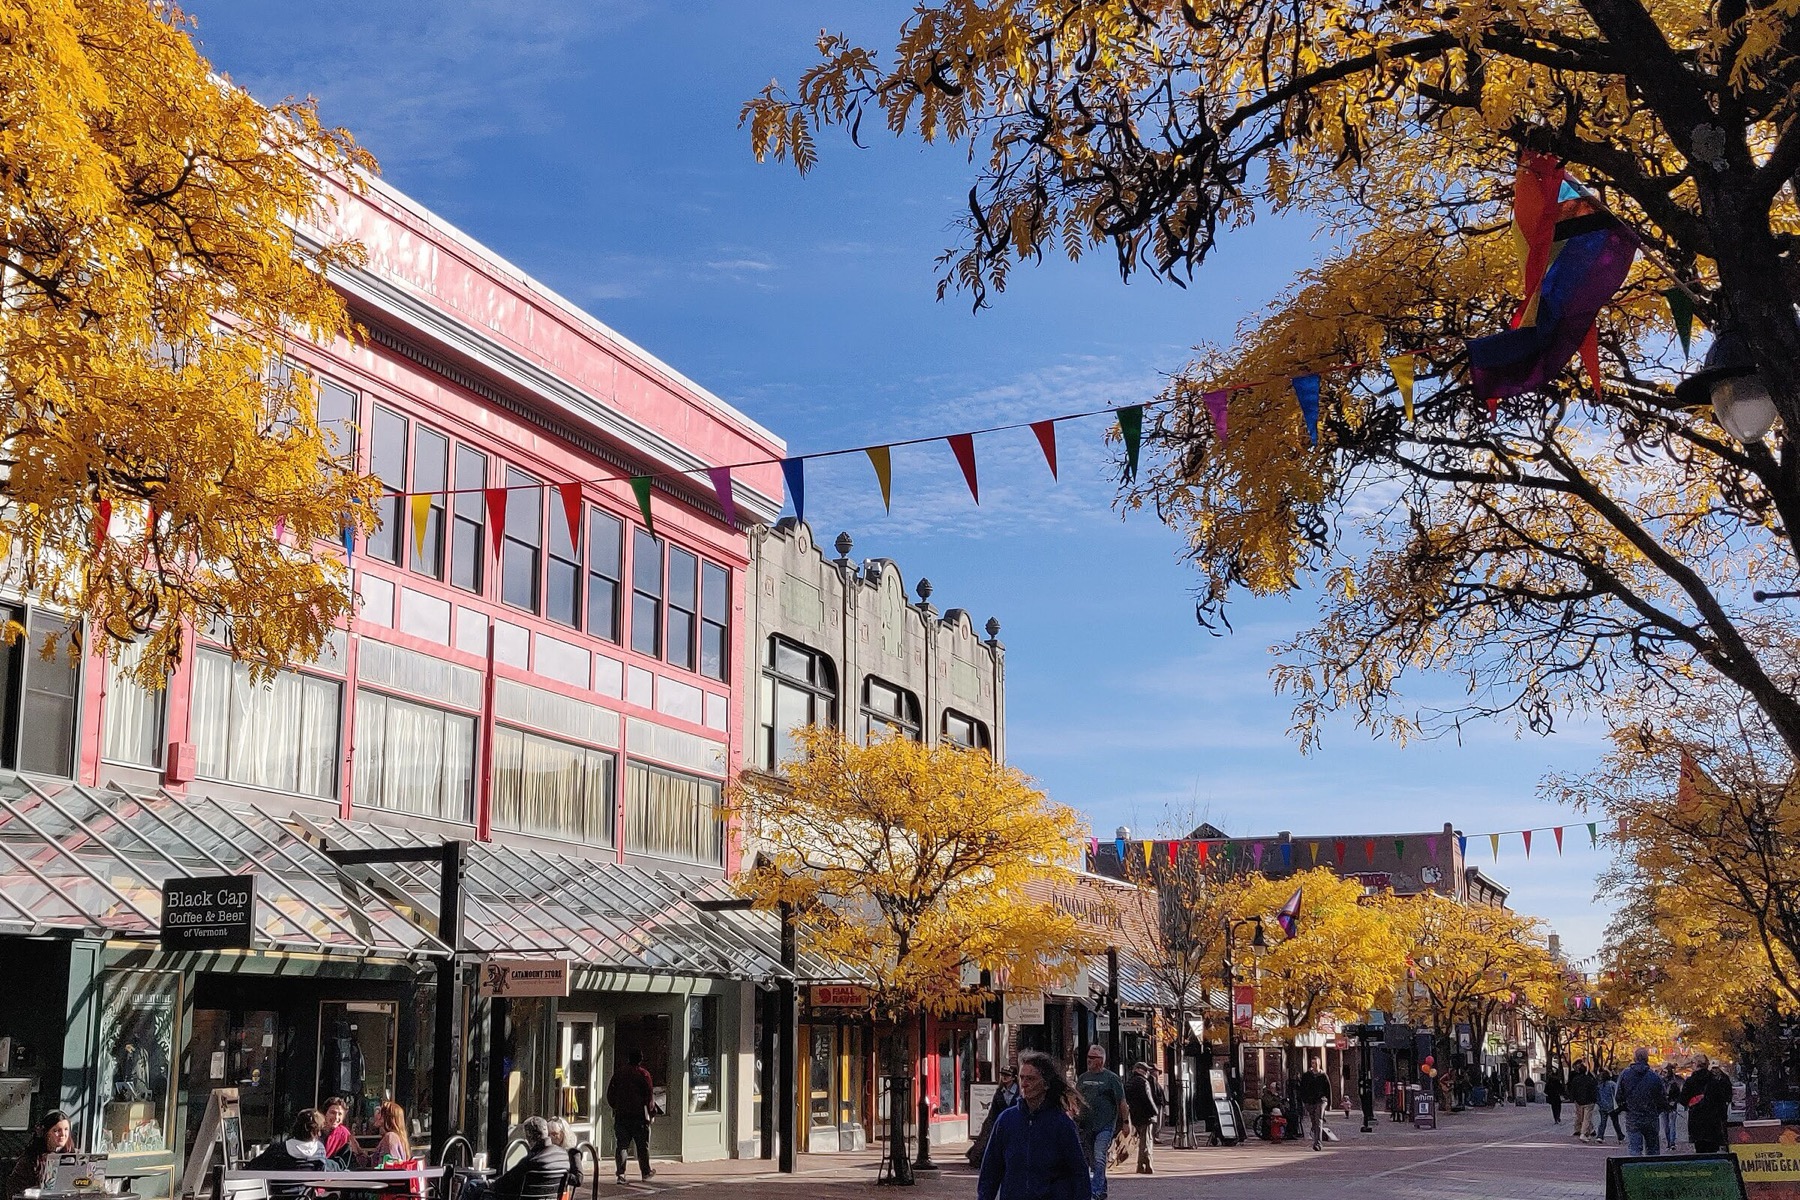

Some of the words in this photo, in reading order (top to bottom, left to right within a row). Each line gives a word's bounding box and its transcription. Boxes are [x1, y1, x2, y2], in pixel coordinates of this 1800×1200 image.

[167, 890, 213, 908] Black
[217, 889, 248, 908] Cap
[169, 912, 203, 924] Coffee
[205, 911, 216, 922] &
[217, 910, 245, 922] Beer
[183, 929, 193, 937] of
[193, 928, 229, 937] Vermont
[511, 970, 543, 979] CATAMOUNT
[544, 970, 563, 978] STORE
[1414, 1093, 1434, 1101] whim
[1741, 1159, 1779, 1172] AMPING
[1780, 1159, 1800, 1172] GEA
